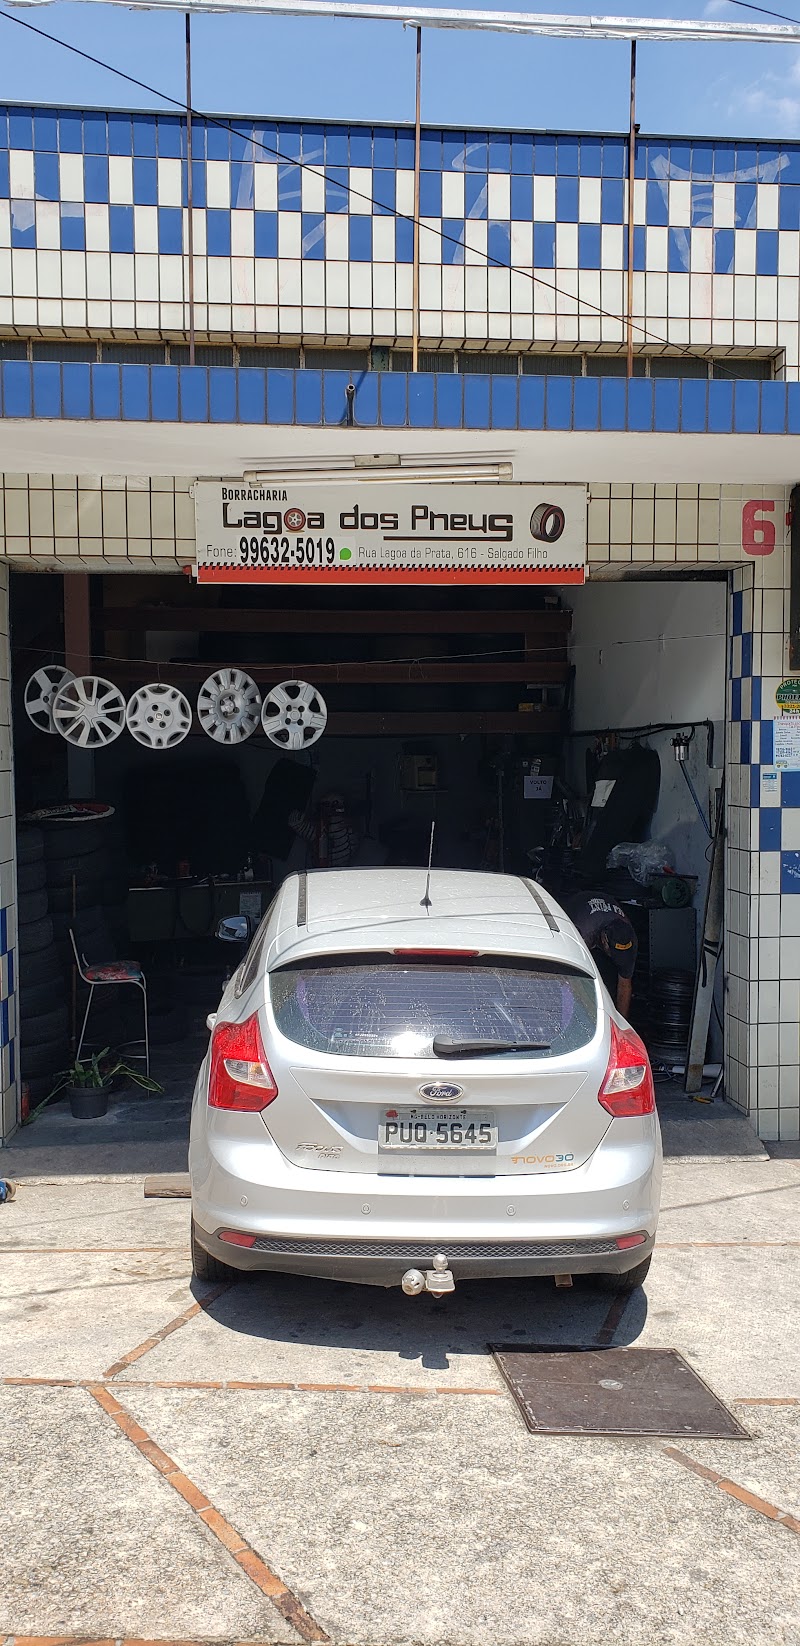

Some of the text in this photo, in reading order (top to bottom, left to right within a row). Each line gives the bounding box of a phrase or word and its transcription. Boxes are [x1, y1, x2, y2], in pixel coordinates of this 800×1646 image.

[221, 487, 288, 501] BORRACHARIA
[222, 502, 513, 541] Lagoa dos Pneus
[206, 544, 238, 558] Fone:
[358, 547, 377, 559] Rua
[380, 547, 407, 561] Lagoa
[410, 547, 421, 559] da
[425, 548, 454, 560] Prata,
[457, 548, 477, 560] 616
[487, 548, 524, 561] Salgado
[527, 549, 548, 560] Filho
[429, 1086, 453, 1097] Ford
